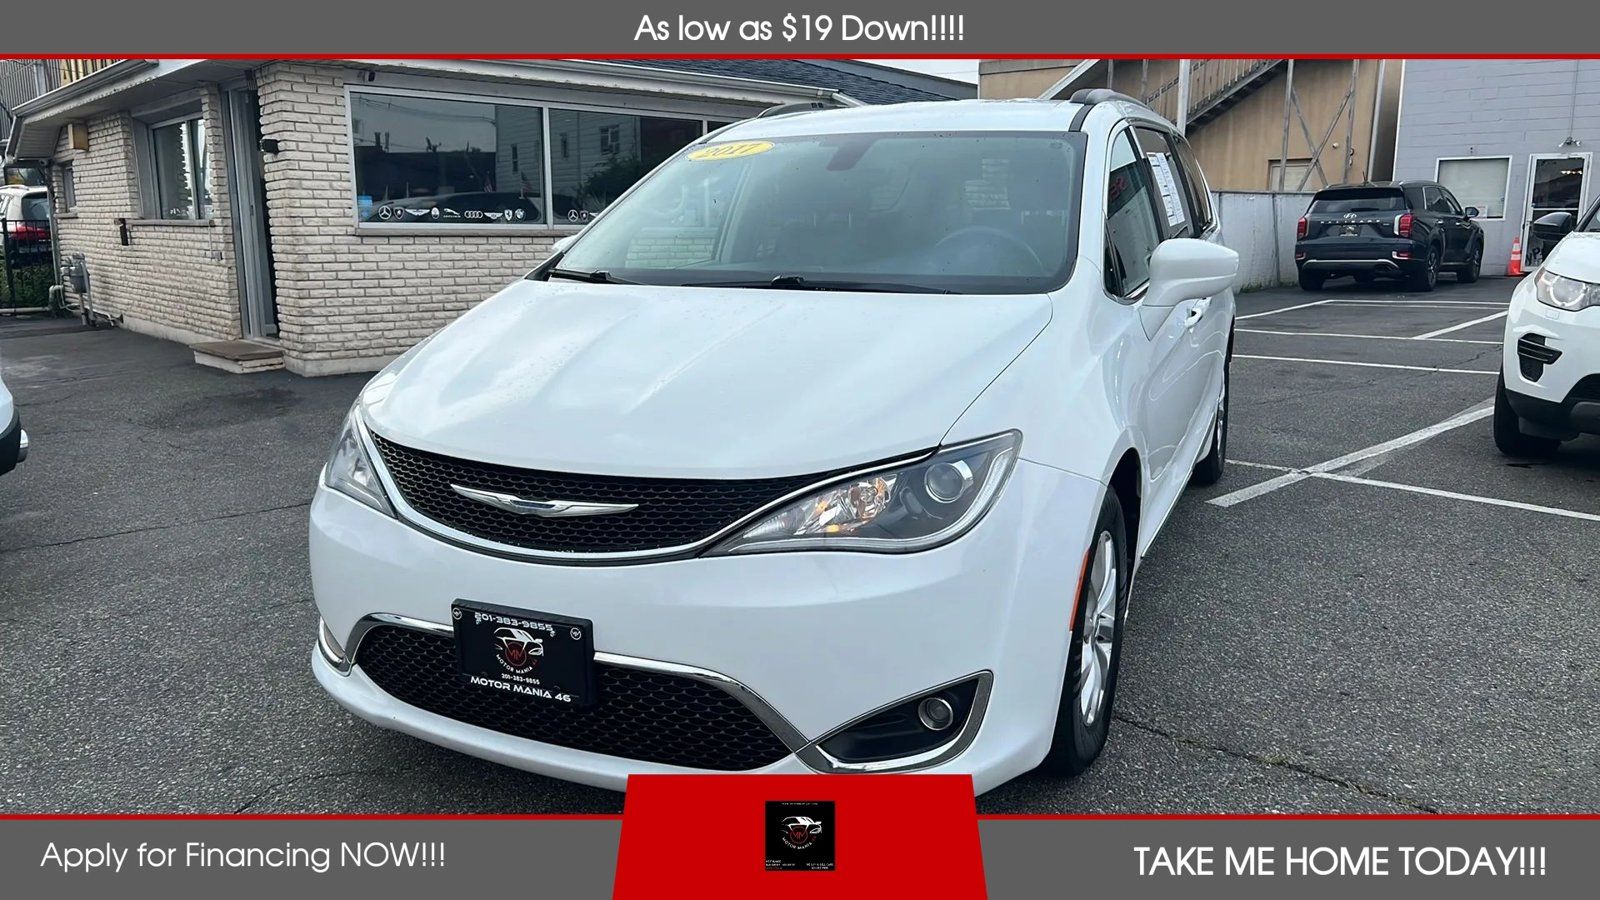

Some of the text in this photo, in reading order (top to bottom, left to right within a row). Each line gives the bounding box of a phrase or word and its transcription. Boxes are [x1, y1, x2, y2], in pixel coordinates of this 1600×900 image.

[474, 612, 553, 631] 201-383-9855
[496, 654, 534, 674] MOTOR MANIA
[470, 676, 572, 702] MOTOR MANIA 46
